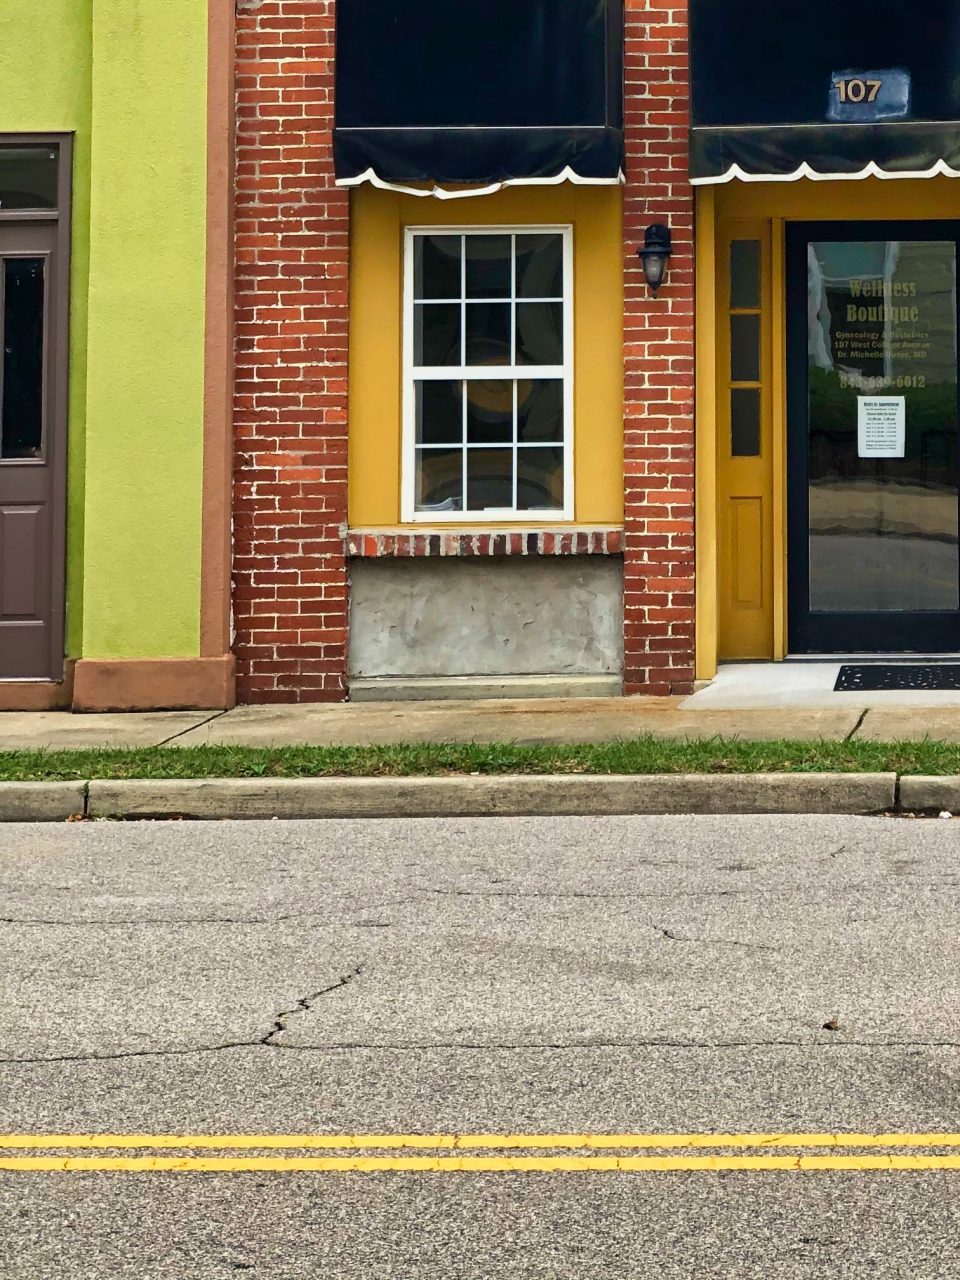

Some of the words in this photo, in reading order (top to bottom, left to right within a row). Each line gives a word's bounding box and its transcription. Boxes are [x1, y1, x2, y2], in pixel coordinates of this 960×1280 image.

[834, 79, 882, 103] 107
[849, 279, 916, 297] Wellness
[846, 304, 919, 323] Boutique
[835, 331, 880, 340] Gynecology
[834, 341, 848, 349] 107
[850, 341, 870, 349] West
